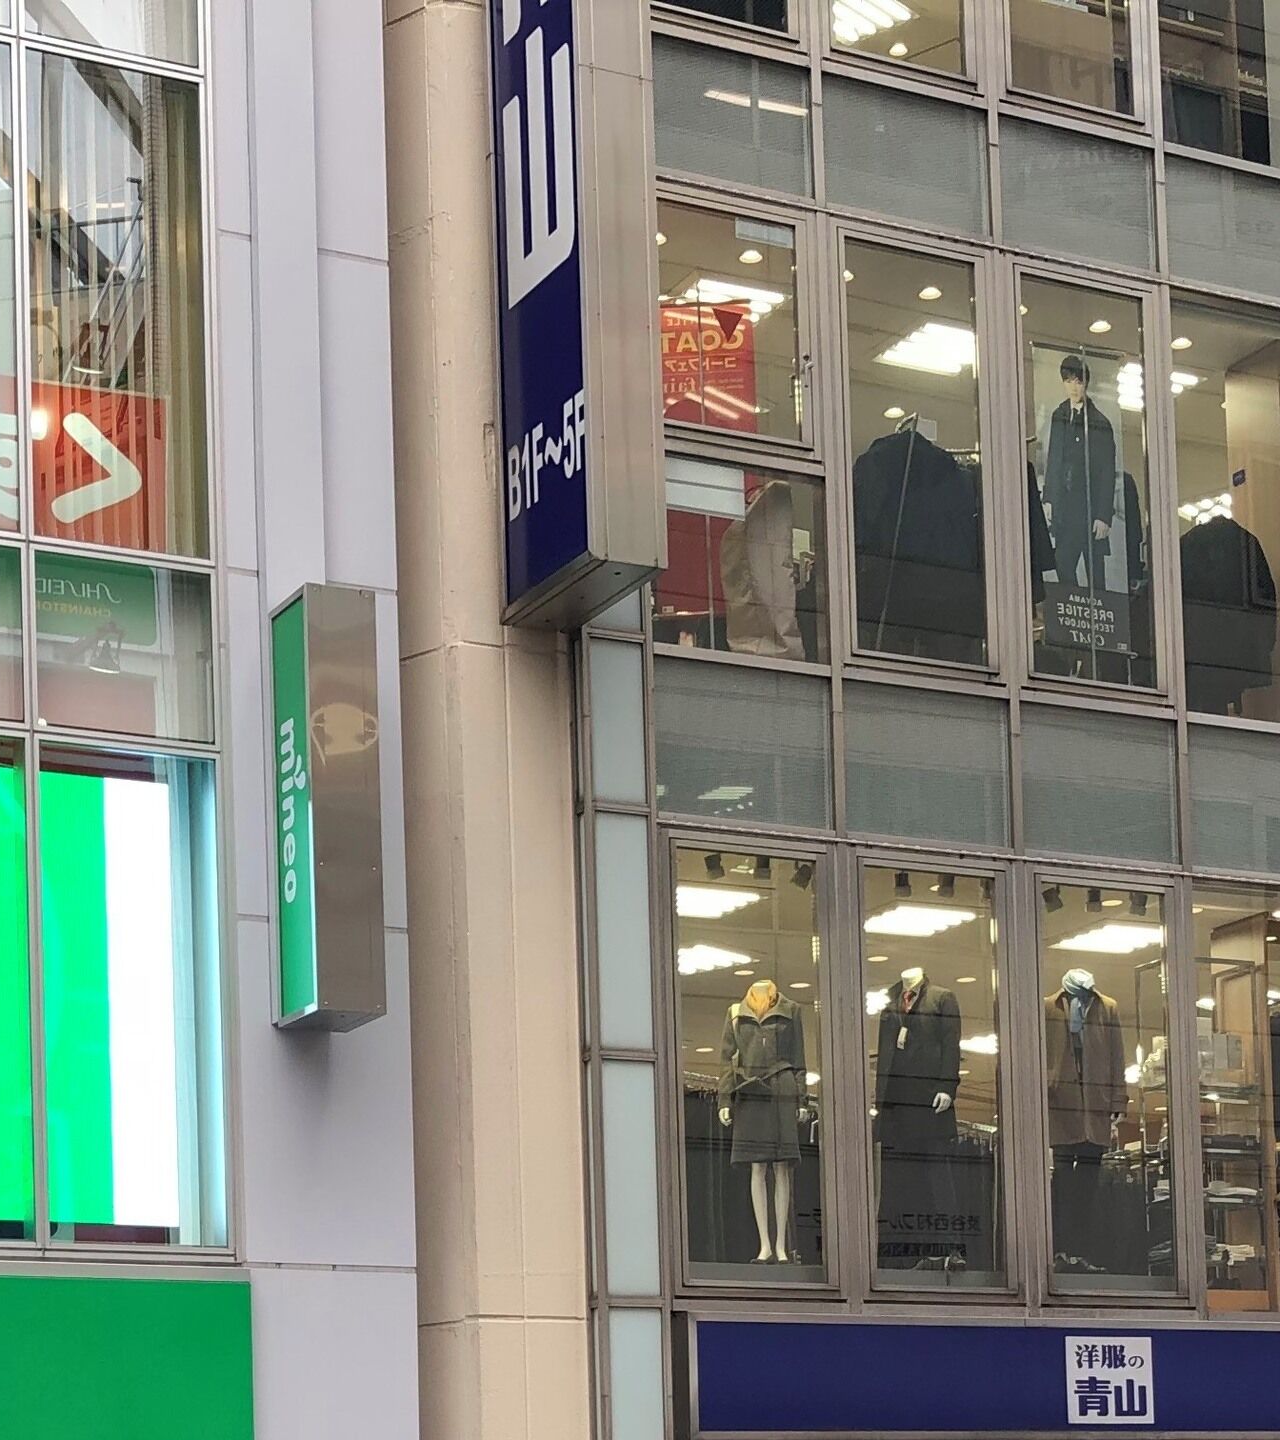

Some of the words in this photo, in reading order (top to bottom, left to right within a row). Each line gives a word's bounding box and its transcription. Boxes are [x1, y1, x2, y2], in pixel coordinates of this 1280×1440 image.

[280, 717, 306, 904] mineo
[1074, 1343, 1145, 1370] 洋服の
[1073, 1375, 1148, 1417] 青山
